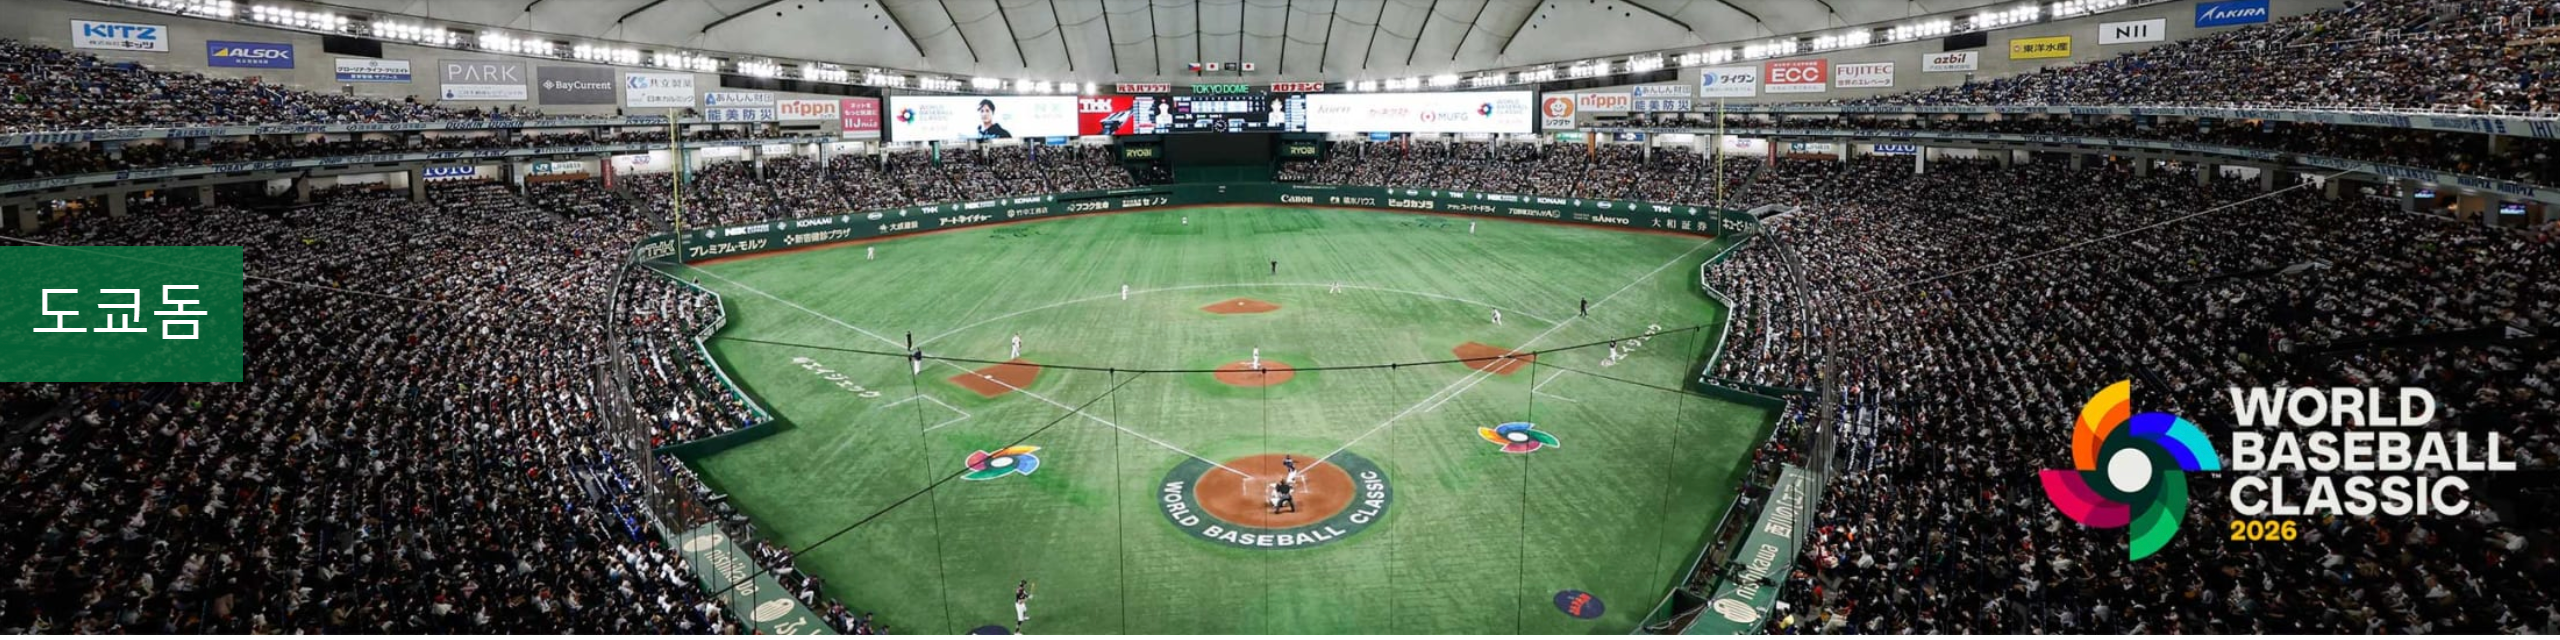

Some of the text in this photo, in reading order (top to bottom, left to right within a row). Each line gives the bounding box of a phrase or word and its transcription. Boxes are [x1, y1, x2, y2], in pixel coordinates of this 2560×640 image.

[2214, 6, 2266, 18] AKIRA
[84, 23, 157, 40] KITZ
[2116, 24, 2148, 40] NII
[121, 40, 154, 49] キッツ
[2024, 41, 2069, 55] 東洋水産
[228, 48, 290, 59] ALSOK
[1933, 53, 1967, 65] azbil
[448, 63, 518, 83] PARK
[1771, 67, 1820, 83] ECC
[1837, 65, 1892, 77] FUJITEC
[555, 80, 612, 91] BayCurrent
[1191, 84, 1249, 94] TOKYO DOME
[1271, 82, 1324, 92] オロナミンC
[1079, 99, 1112, 112] THK
[1580, 93, 1628, 109] nippn
[1635, 100, 1689, 111] 能美防災
[707, 108, 773, 121] 能美防災
[781, 100, 836, 117] nippn
[1545, 118, 1571, 126] シマダヤ
[1126, 148, 1152, 157] RYOBI
[1291, 146, 1316, 155] RYOBI
[1280, 194, 1314, 204] Canon
[796, 216, 833, 228] KONAMI
[1591, 214, 1630, 225] SANKYO
[689, 237, 768, 258] プレミアム・モルツ
[1163, 470, 1385, 547] WORLD BASEBALL CLASSIC
[704, 547, 760, 597] nishikawa
[1736, 543, 1780, 601] nishikawa
